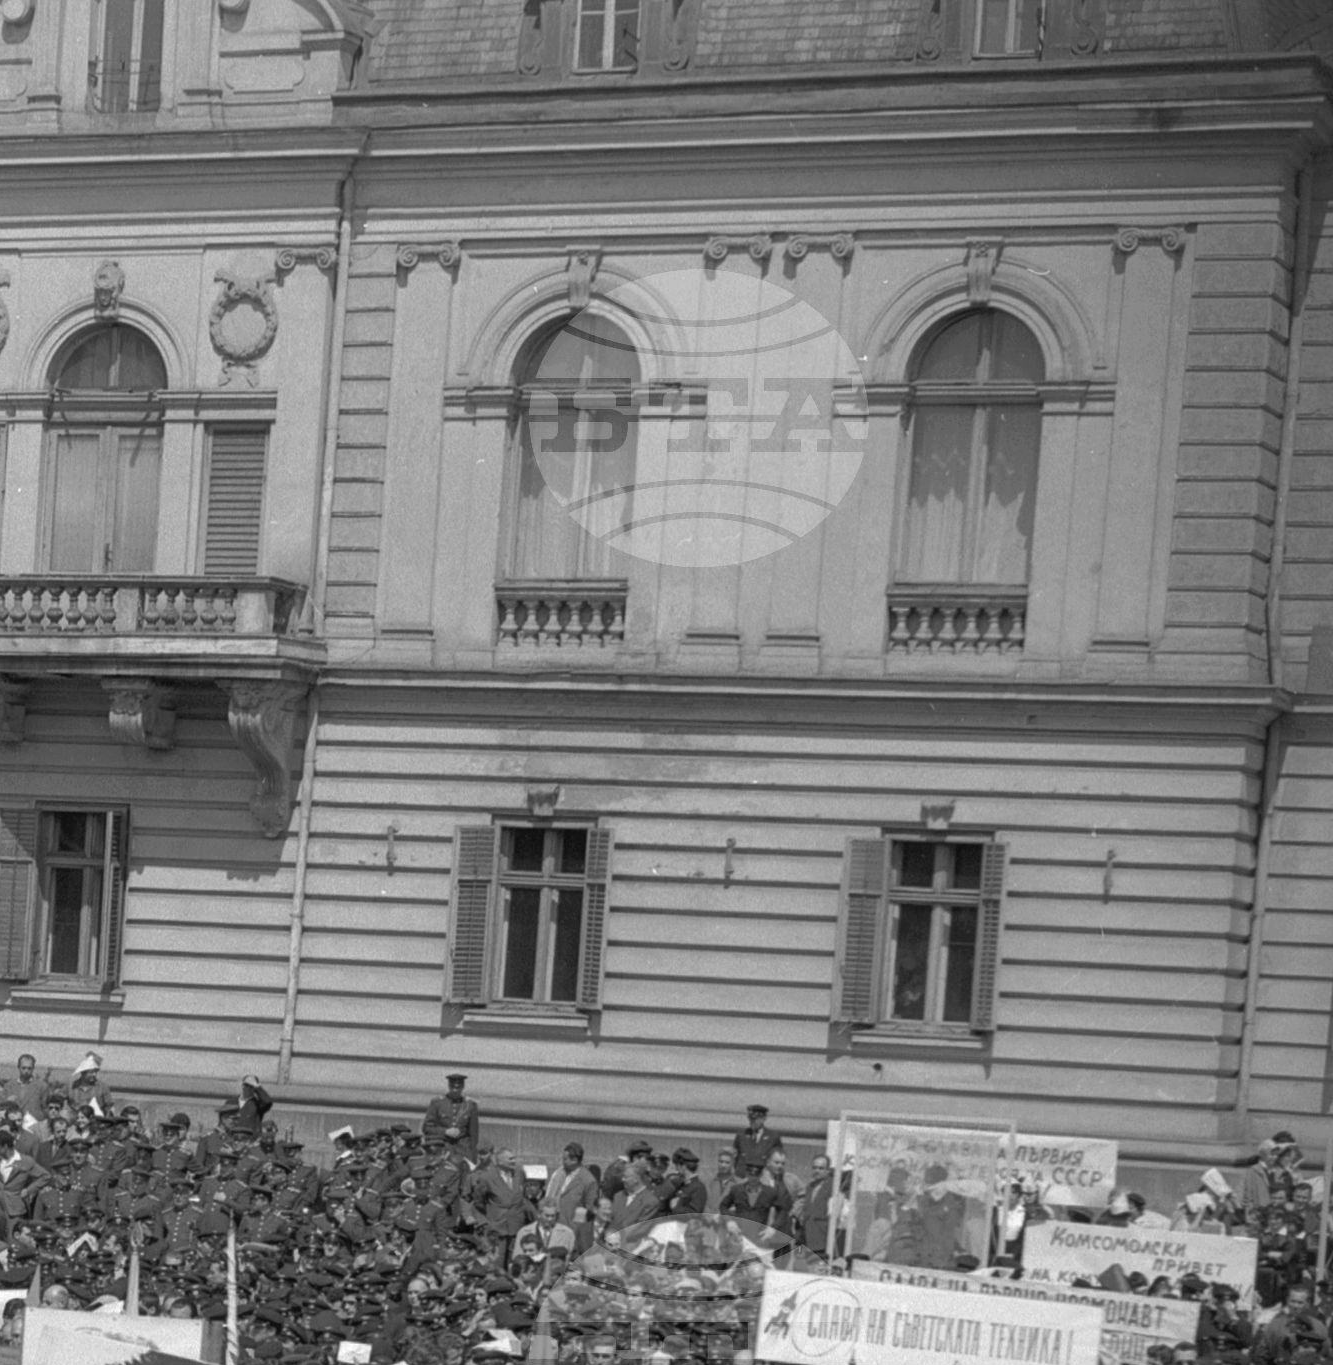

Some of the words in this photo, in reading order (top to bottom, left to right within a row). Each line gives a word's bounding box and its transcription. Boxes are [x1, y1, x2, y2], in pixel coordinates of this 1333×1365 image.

[1015, 1145, 1085, 1165] ПЪРВИЯ
[1051, 1168, 1104, 1188] СССР
[1151, 1257, 1228, 1278] ПРИВЕТ
[866, 1308, 887, 1346] НА
[891, 1311, 980, 1356] СЪВЕТСКАТА
[989, 1322, 1074, 1365] ТЕХНИКА!
